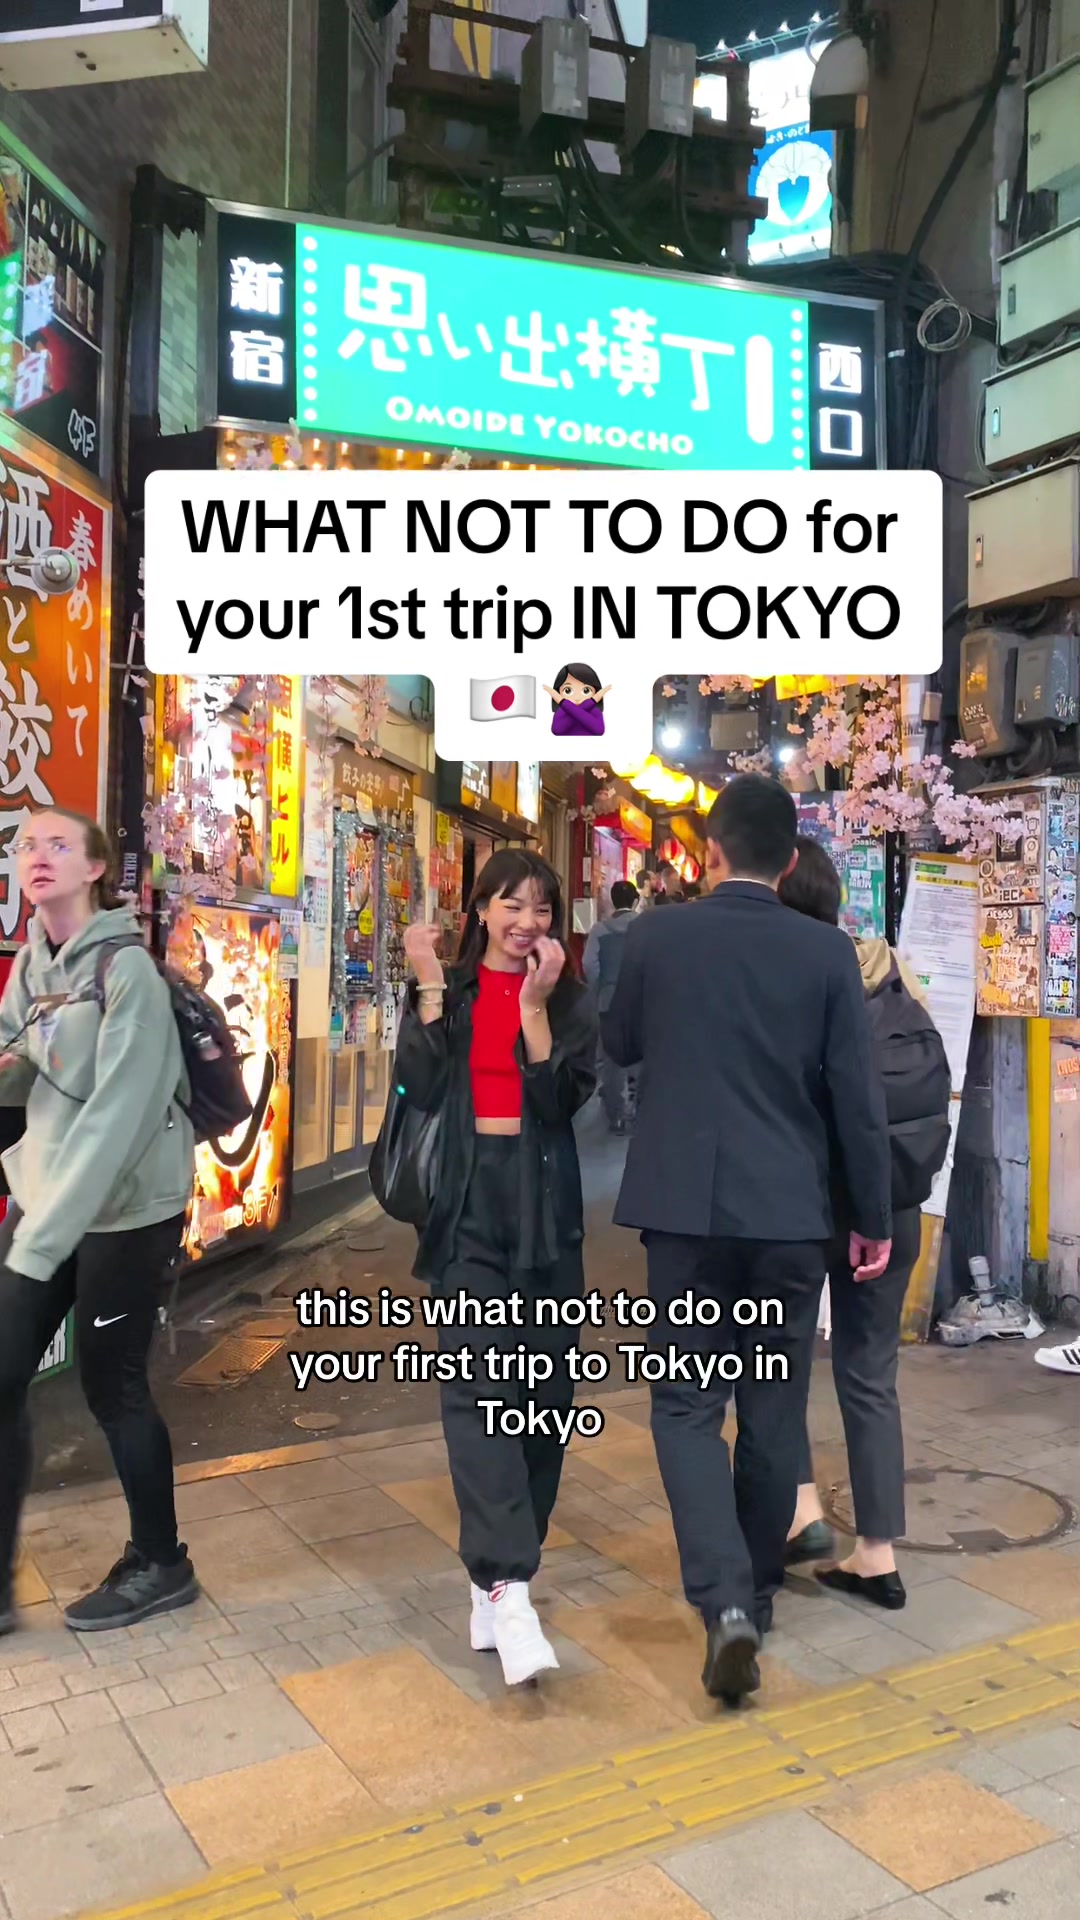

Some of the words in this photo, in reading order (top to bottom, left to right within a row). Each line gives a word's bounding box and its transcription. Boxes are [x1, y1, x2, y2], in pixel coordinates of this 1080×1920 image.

[230, 256, 284, 386] 新宿
[338, 262, 736, 412] 思い出横丁
[386, 396, 525, 435] OMOIDE
[534, 418, 693, 455] YOKOCHO
[818, 342, 864, 458] 西口
[66, 509, 97, 757] 春めいて
[243, 1185, 267, 1227] 3F
